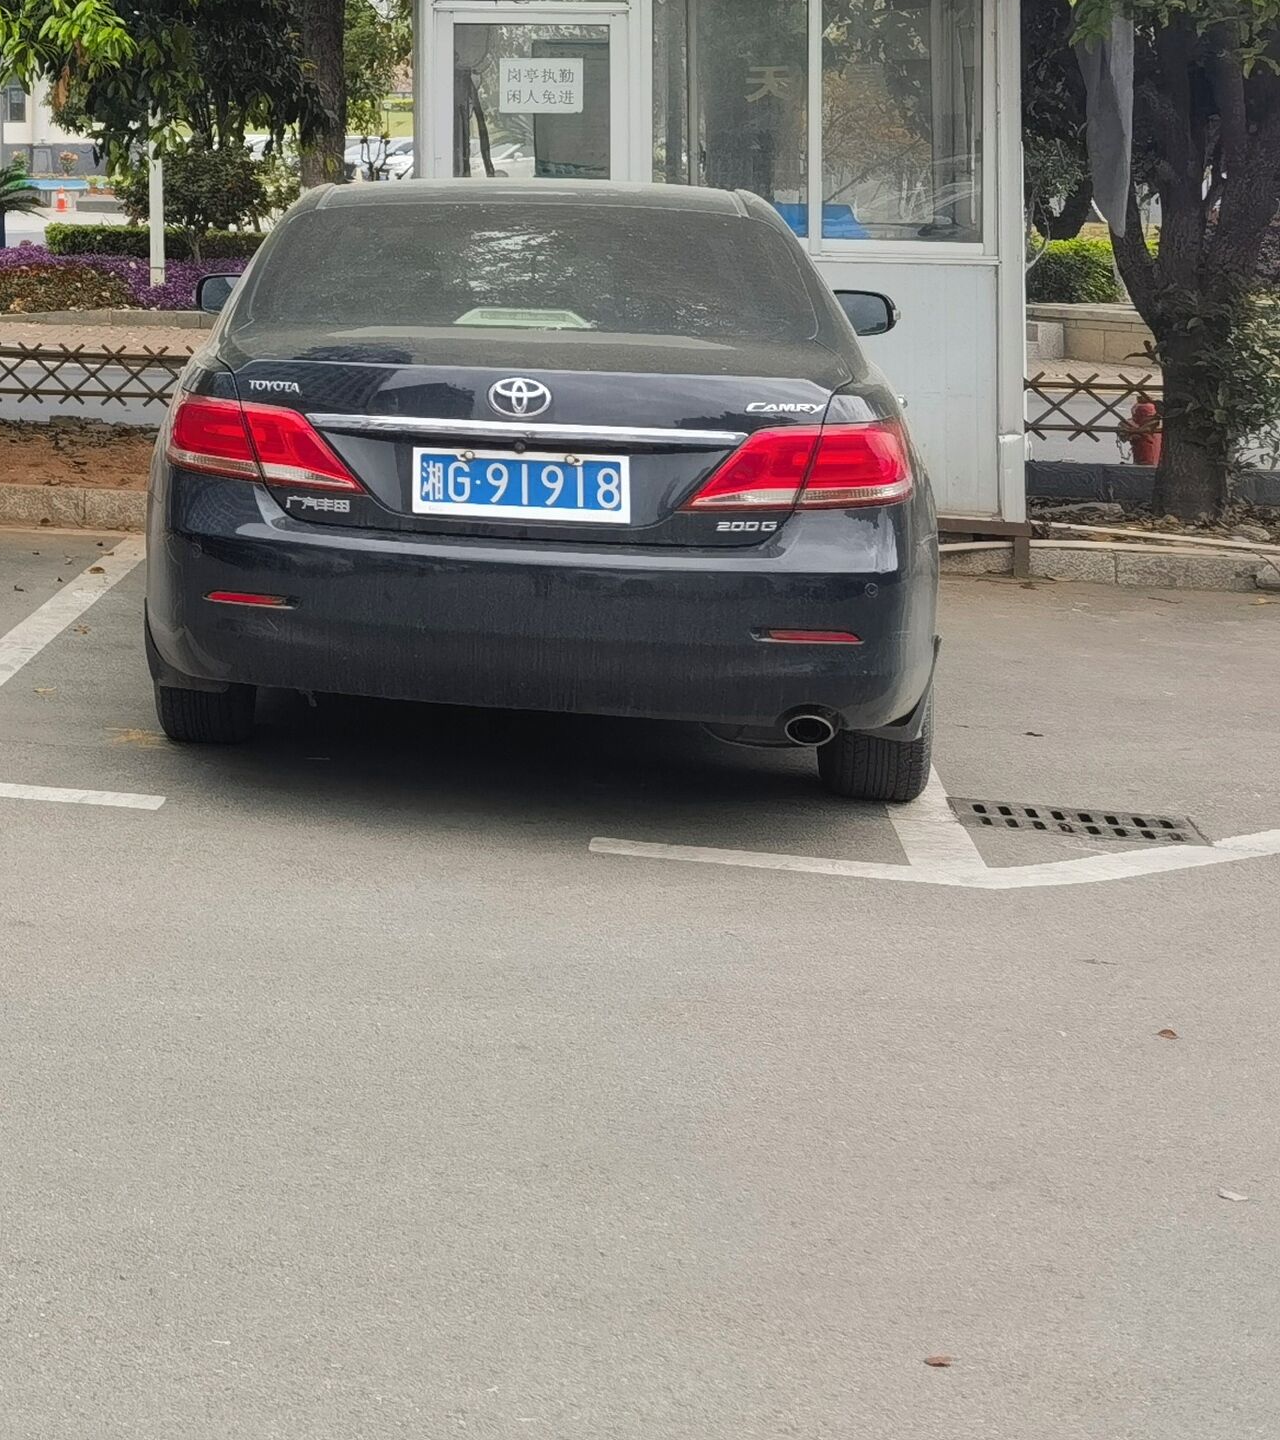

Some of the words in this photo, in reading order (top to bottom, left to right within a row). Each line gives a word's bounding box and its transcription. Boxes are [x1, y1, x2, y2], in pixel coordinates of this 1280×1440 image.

[507, 68, 574, 83] 岗亭执勤
[507, 89, 574, 104] 闲人免进
[248, 379, 300, 393] TOYOTA
[745, 402, 827, 414] CAMRY
[286, 495, 350, 513] 广汽丰田
